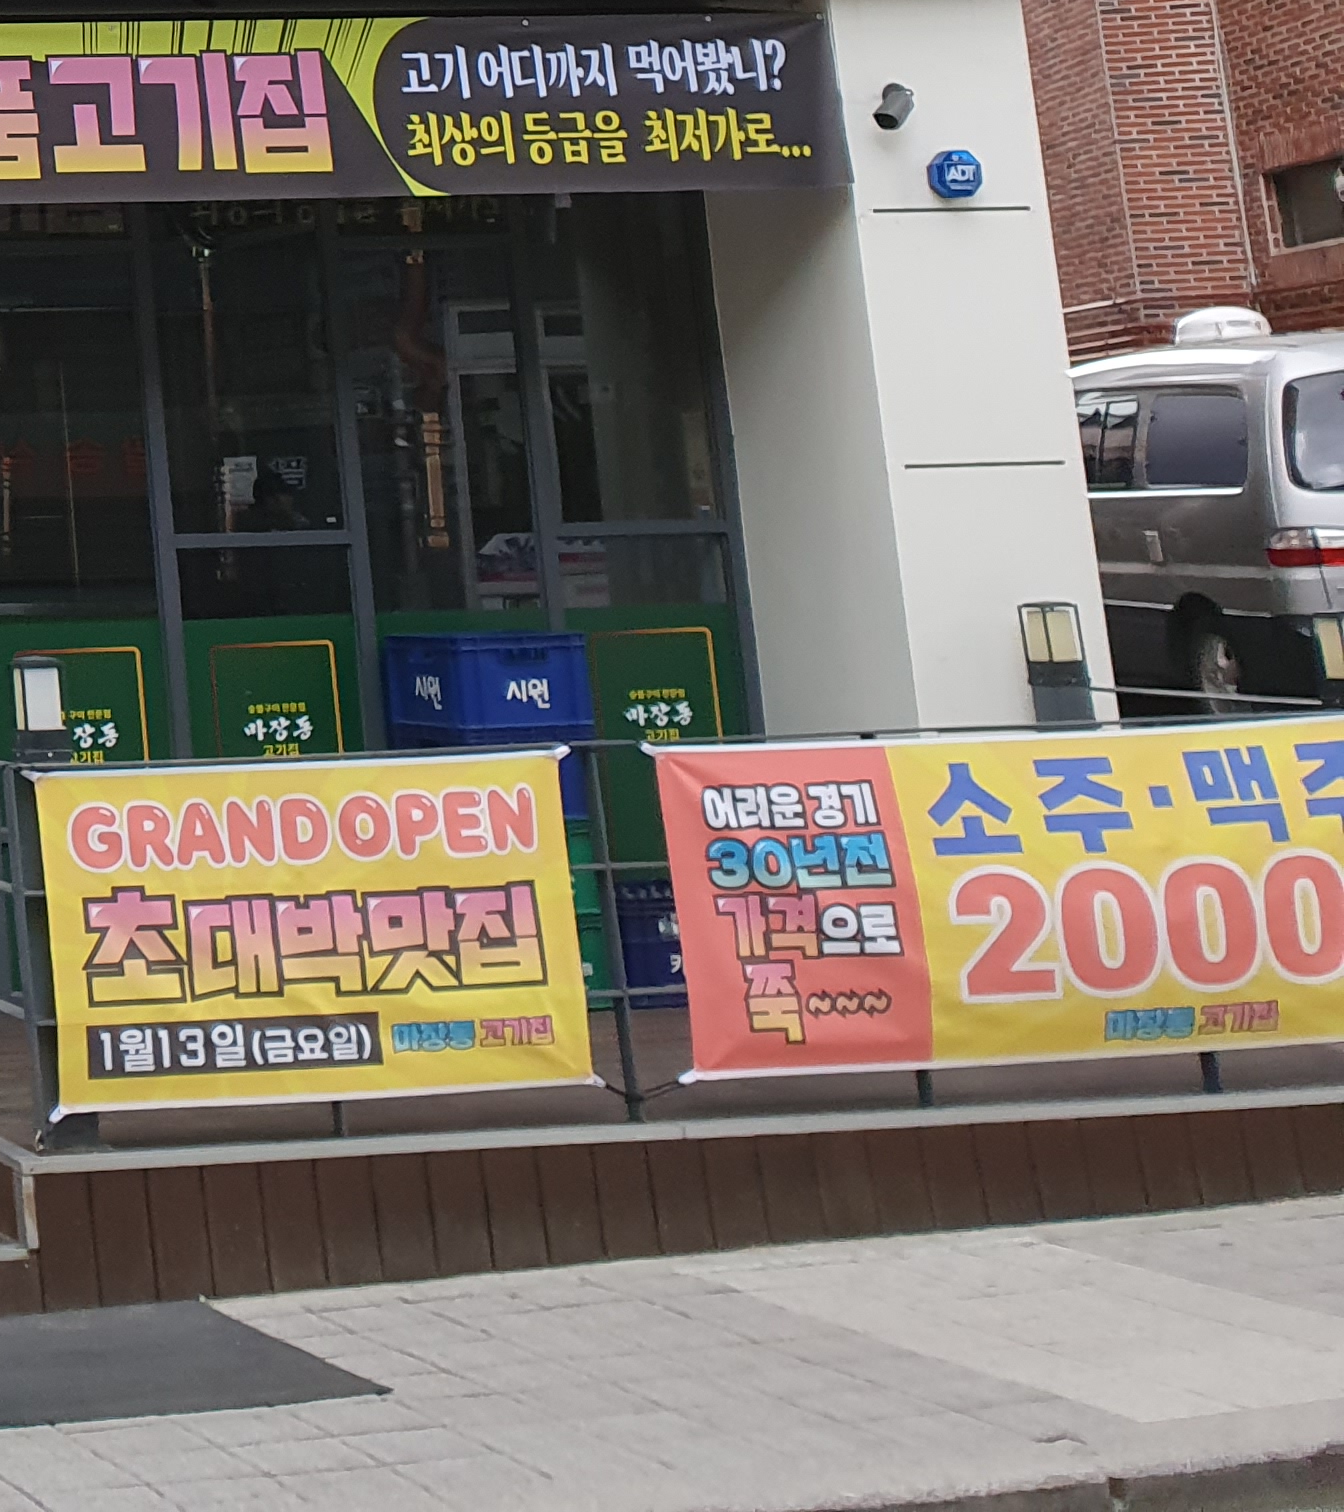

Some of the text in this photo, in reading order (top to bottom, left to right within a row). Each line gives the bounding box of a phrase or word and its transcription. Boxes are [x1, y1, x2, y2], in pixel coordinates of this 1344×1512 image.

[401, 38, 788, 101] 고기 어디까지 먹어봤니?
[407, 109, 516, 168] 최상의
[522, 109, 629, 166] 등급을
[946, 165, 977, 182] ADT
[414, 675, 443, 710] 시원
[506, 678, 551, 709] 시원
[243, 714, 314, 742] 마장동
[622, 700, 694, 727] 마장동
[72, 721, 120, 749] 장동
[701, 779, 882, 831] 어려운 경기
[68, 782, 538, 873] GRAND OPEN
[713, 889, 905, 961] 가격으로
[947, 846, 1343, 1004] 2000
[479, 1014, 555, 1048] 고기집
